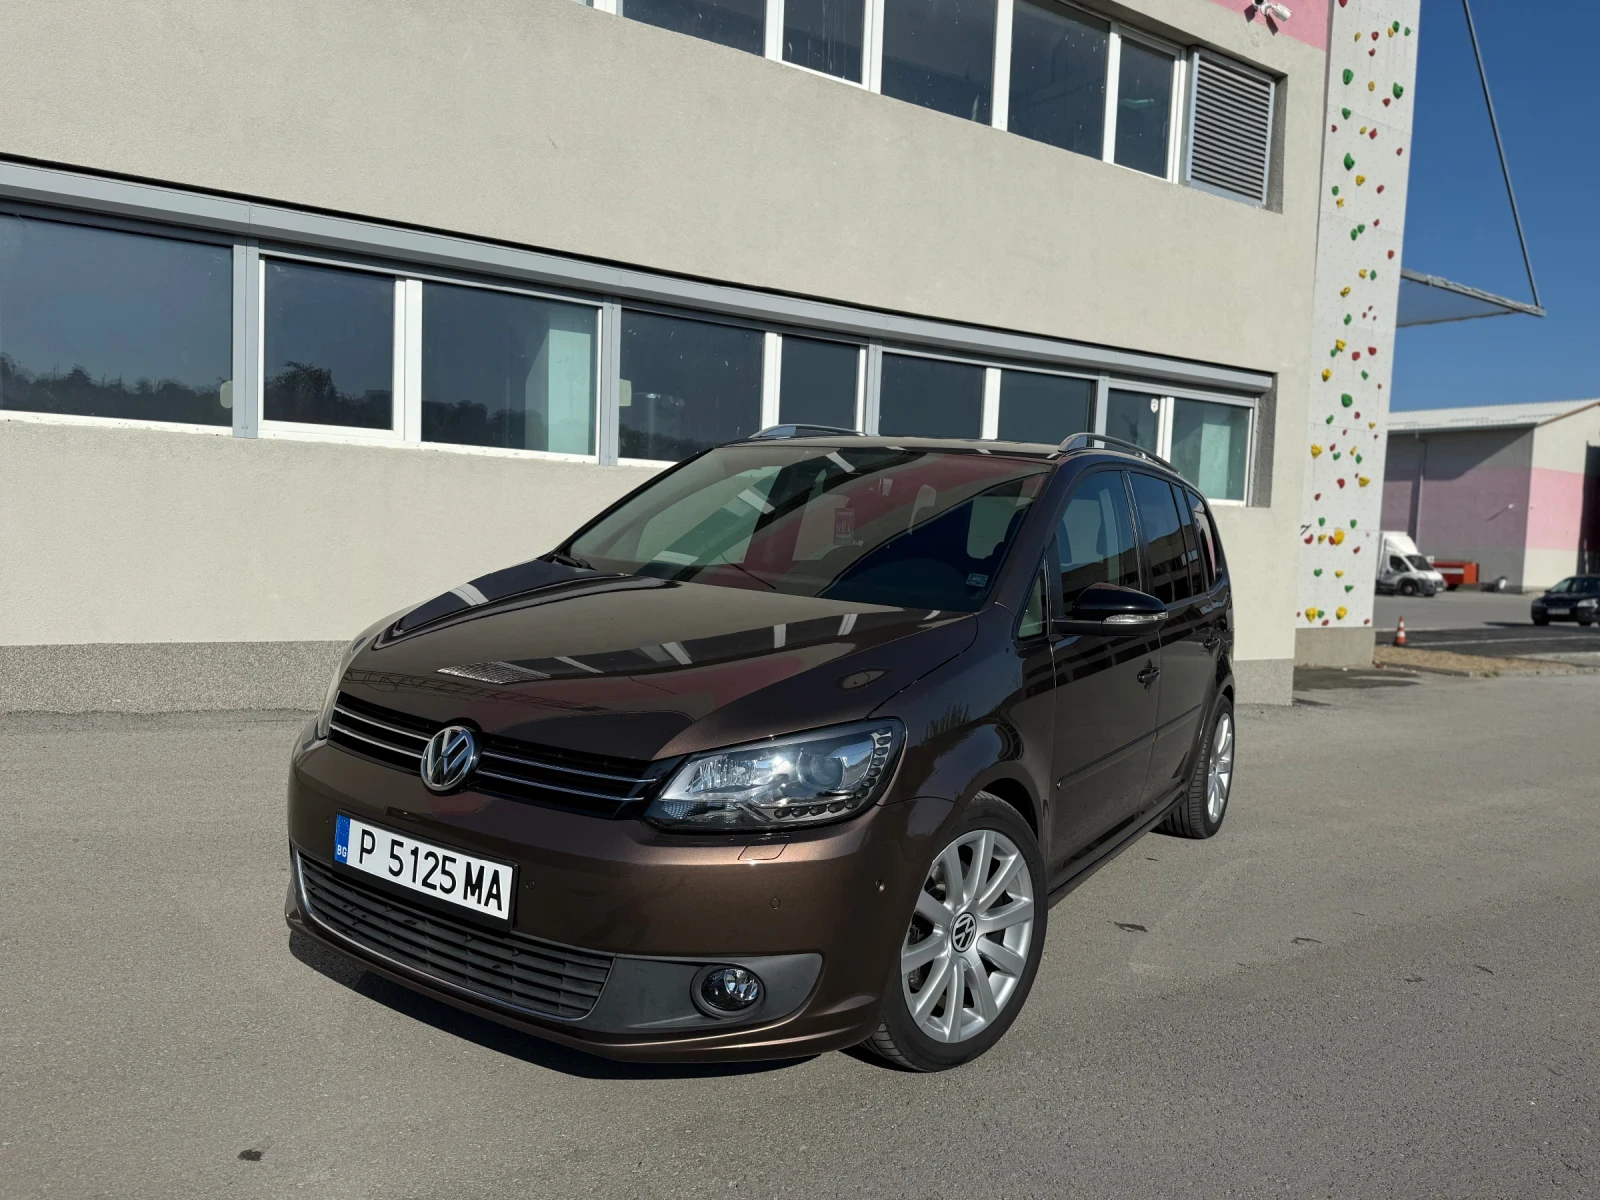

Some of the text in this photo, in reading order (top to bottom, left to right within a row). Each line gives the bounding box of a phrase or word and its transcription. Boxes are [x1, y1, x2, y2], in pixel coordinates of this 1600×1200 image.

[421, 726, 474, 791] VW
[336, 844, 347, 858] BG
[358, 828, 503, 912] P 5125 MA
